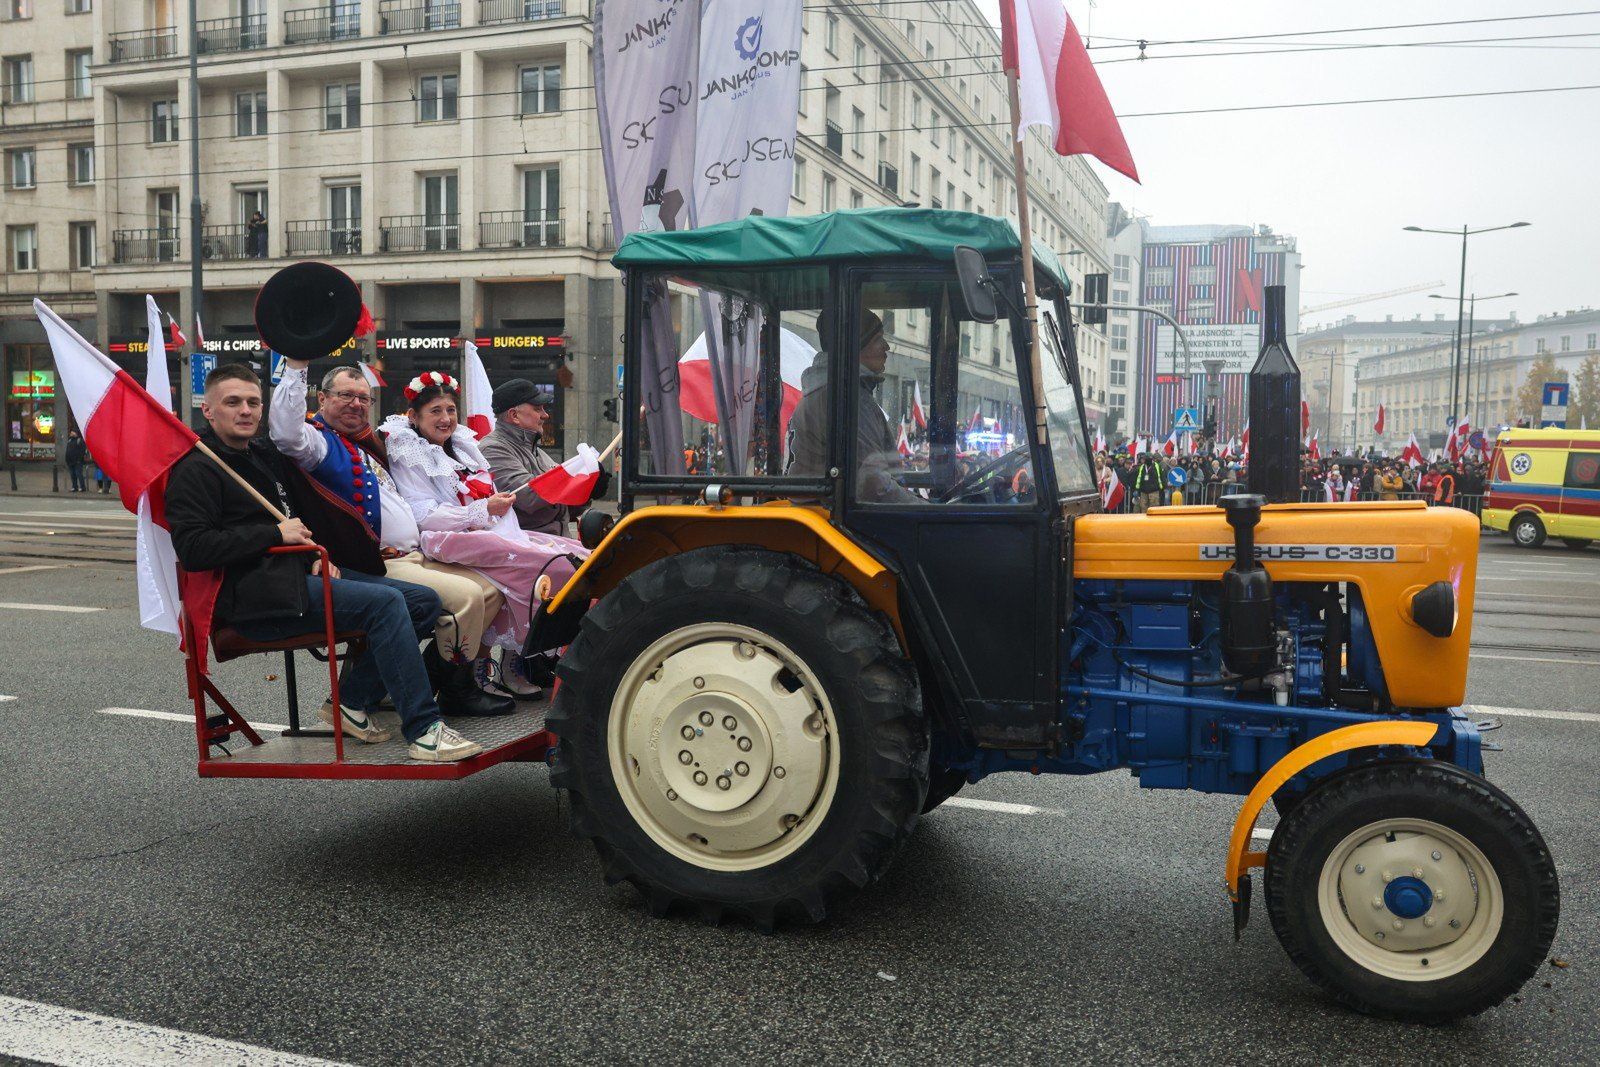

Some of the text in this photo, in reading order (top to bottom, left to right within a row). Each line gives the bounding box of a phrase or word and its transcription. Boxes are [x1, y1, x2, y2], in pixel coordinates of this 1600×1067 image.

[700, 50, 800, 100] JANKOOMP
[128, 343, 148, 352] STEA
[223, 340, 231, 351] &
[232, 340, 261, 351] CHIPS
[386, 337, 450, 349] LIVE SPORTS
[493, 336, 545, 348] BURGERS
[1175, 339, 1242, 348] FRNKENSTEIN TO
[1164, 351, 1203, 359] NAZWSKO
[1325, 547, 1394, 560] C-330
